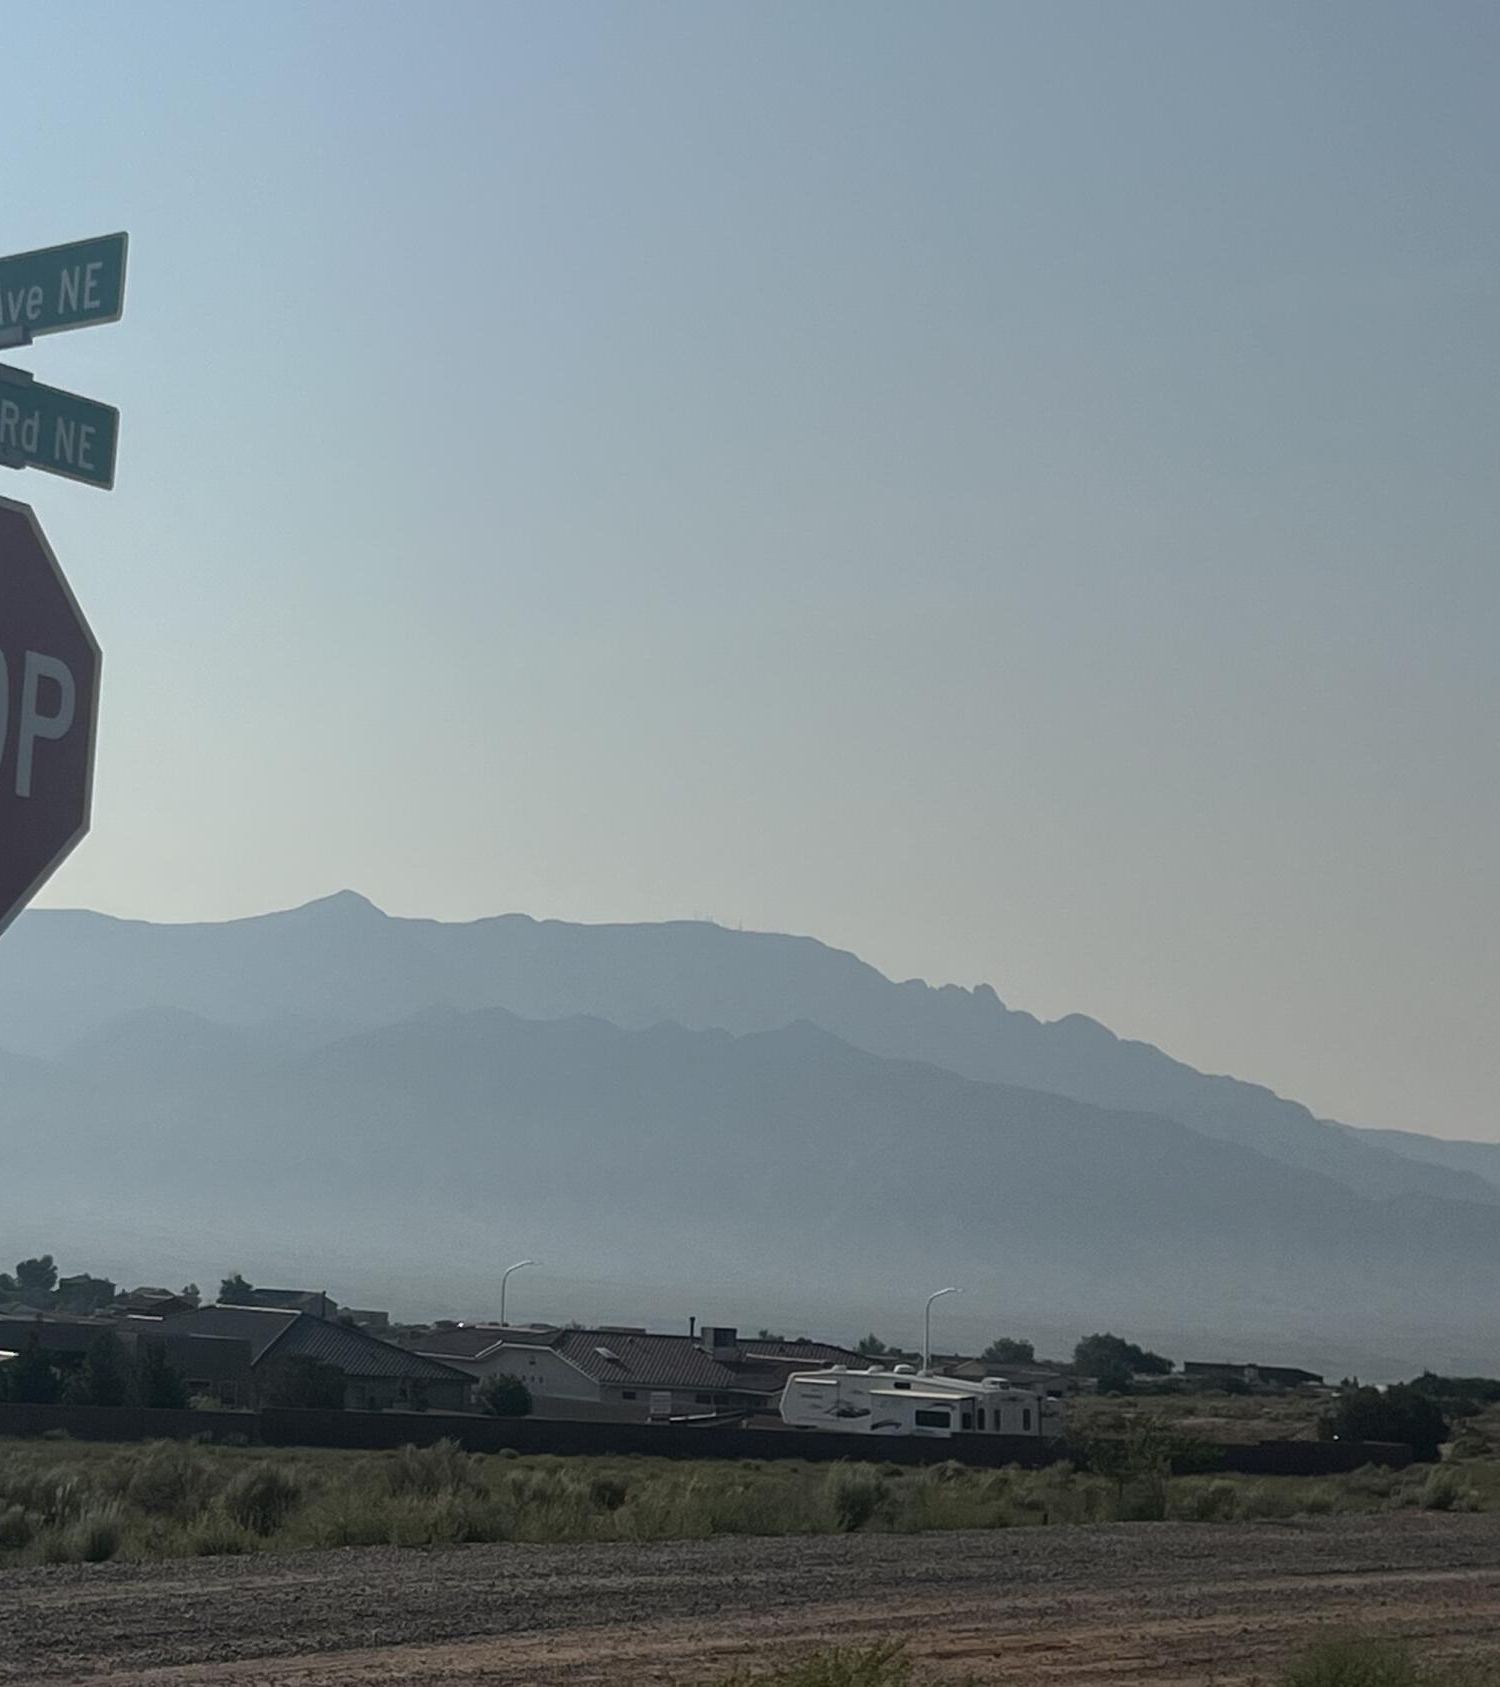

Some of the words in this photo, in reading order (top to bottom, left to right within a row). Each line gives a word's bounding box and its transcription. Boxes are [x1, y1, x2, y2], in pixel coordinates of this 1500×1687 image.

[58, 262, 103, 315] NE
[0, 400, 40, 452] Rd
[54, 417, 97, 470] NE
